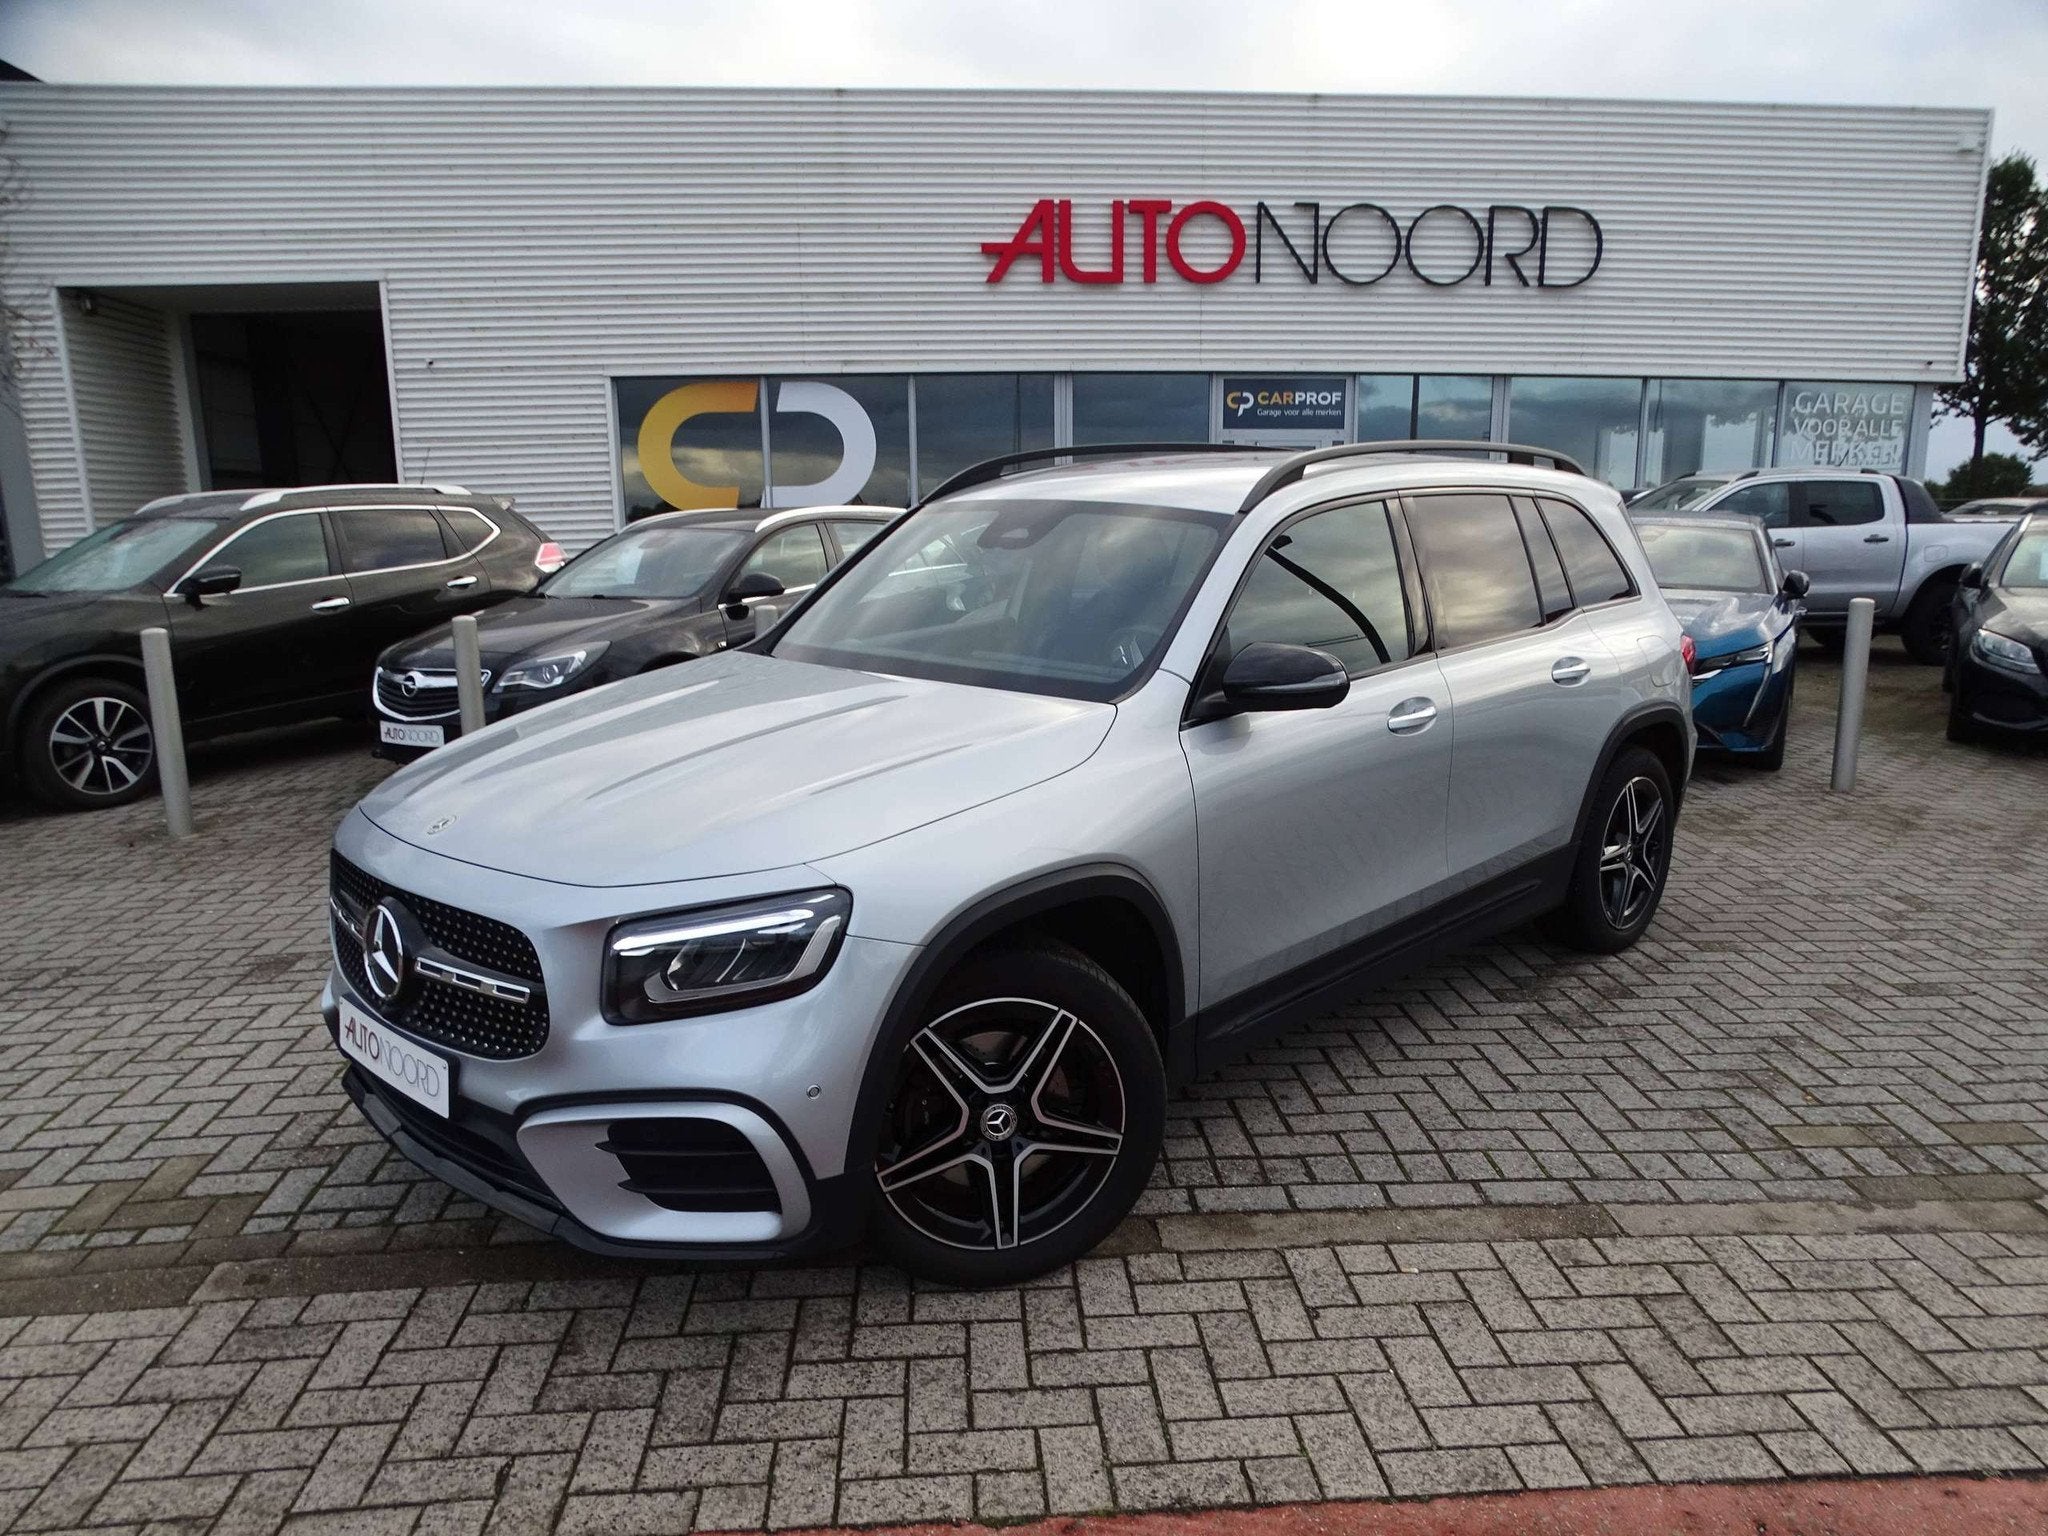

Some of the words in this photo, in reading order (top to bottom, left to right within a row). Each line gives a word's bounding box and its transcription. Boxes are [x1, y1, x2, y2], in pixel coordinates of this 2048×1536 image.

[1257, 391, 1342, 406] CARPROF
[1794, 391, 1904, 415] GARAGE
[1257, 408, 1282, 417] Garage
[1301, 408, 1314, 416] alle
[1315, 408, 1341, 416] merken
[1794, 418, 1850, 437] VOOR
[1854, 419, 1903, 437] ALLE
